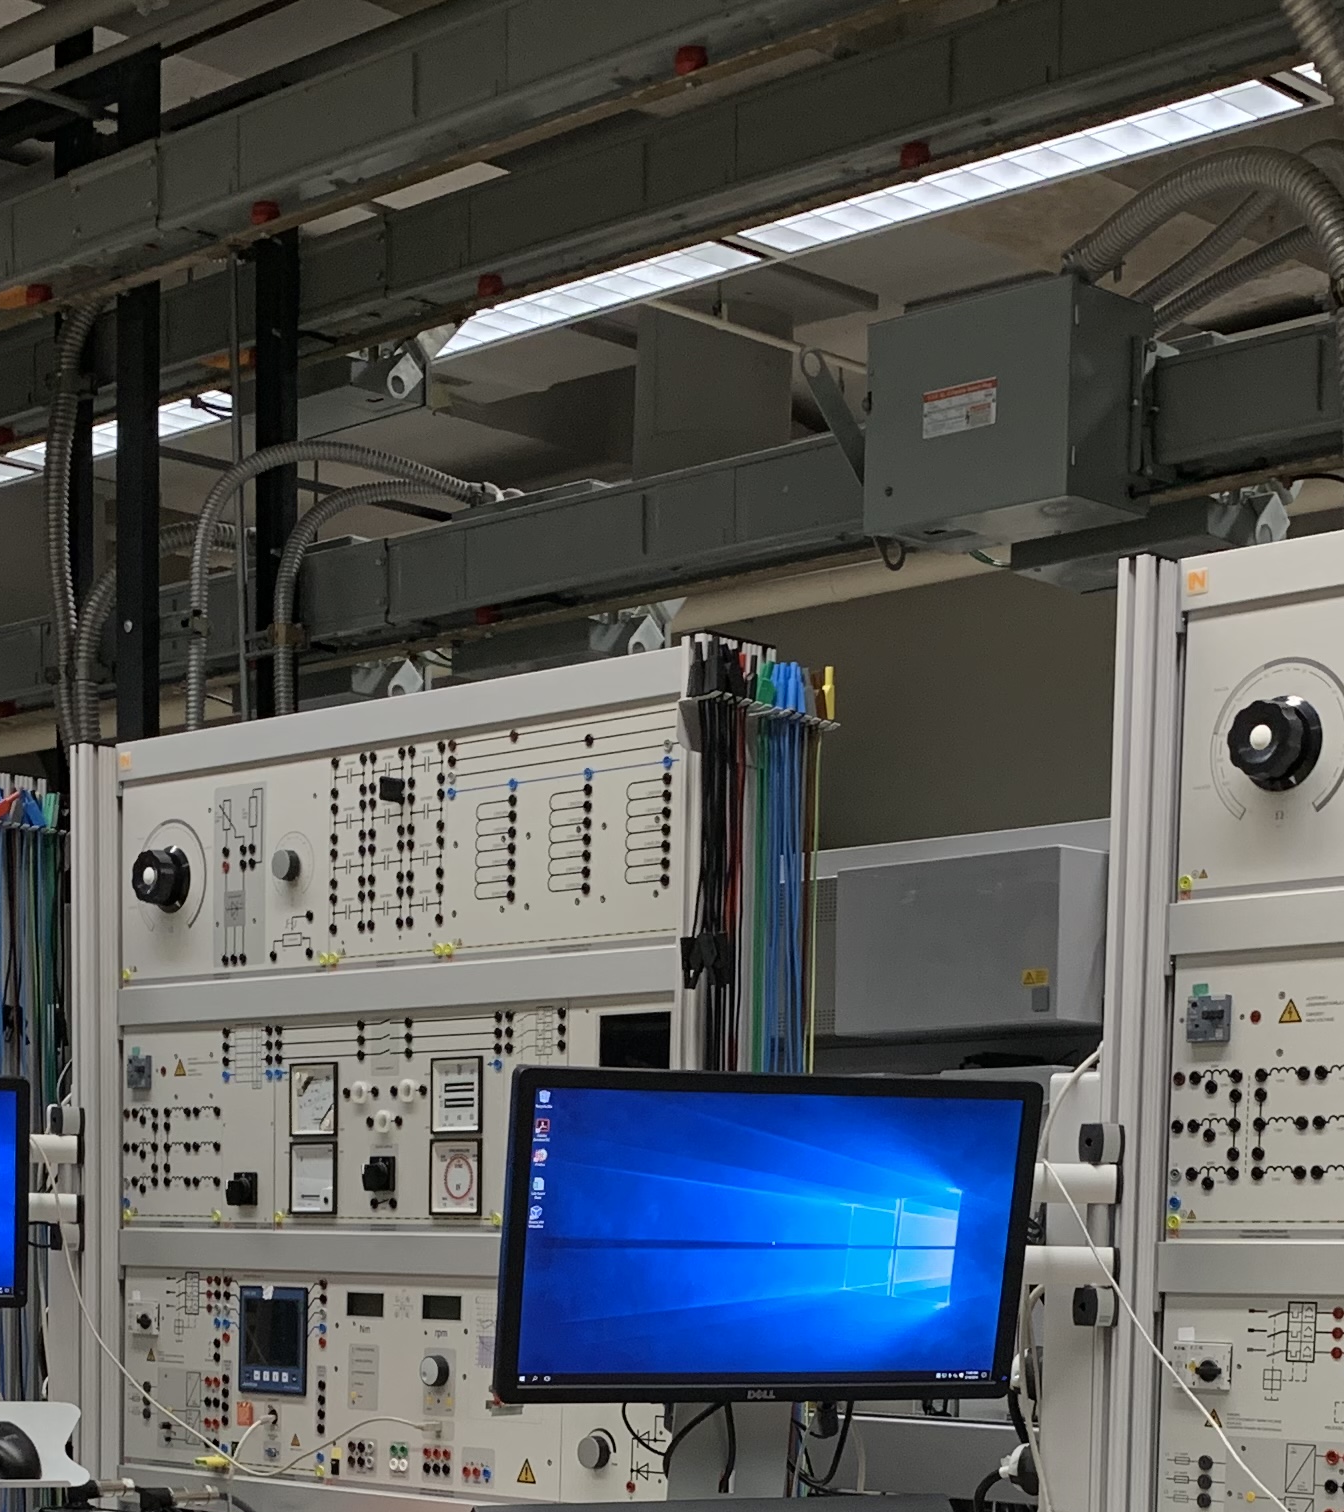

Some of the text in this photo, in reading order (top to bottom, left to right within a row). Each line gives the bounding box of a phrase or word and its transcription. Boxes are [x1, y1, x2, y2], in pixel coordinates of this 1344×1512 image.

[359, 1325, 370, 1334] Nm
[434, 1329, 448, 1338] rpm
[747, 1389, 776, 1399] DELL
